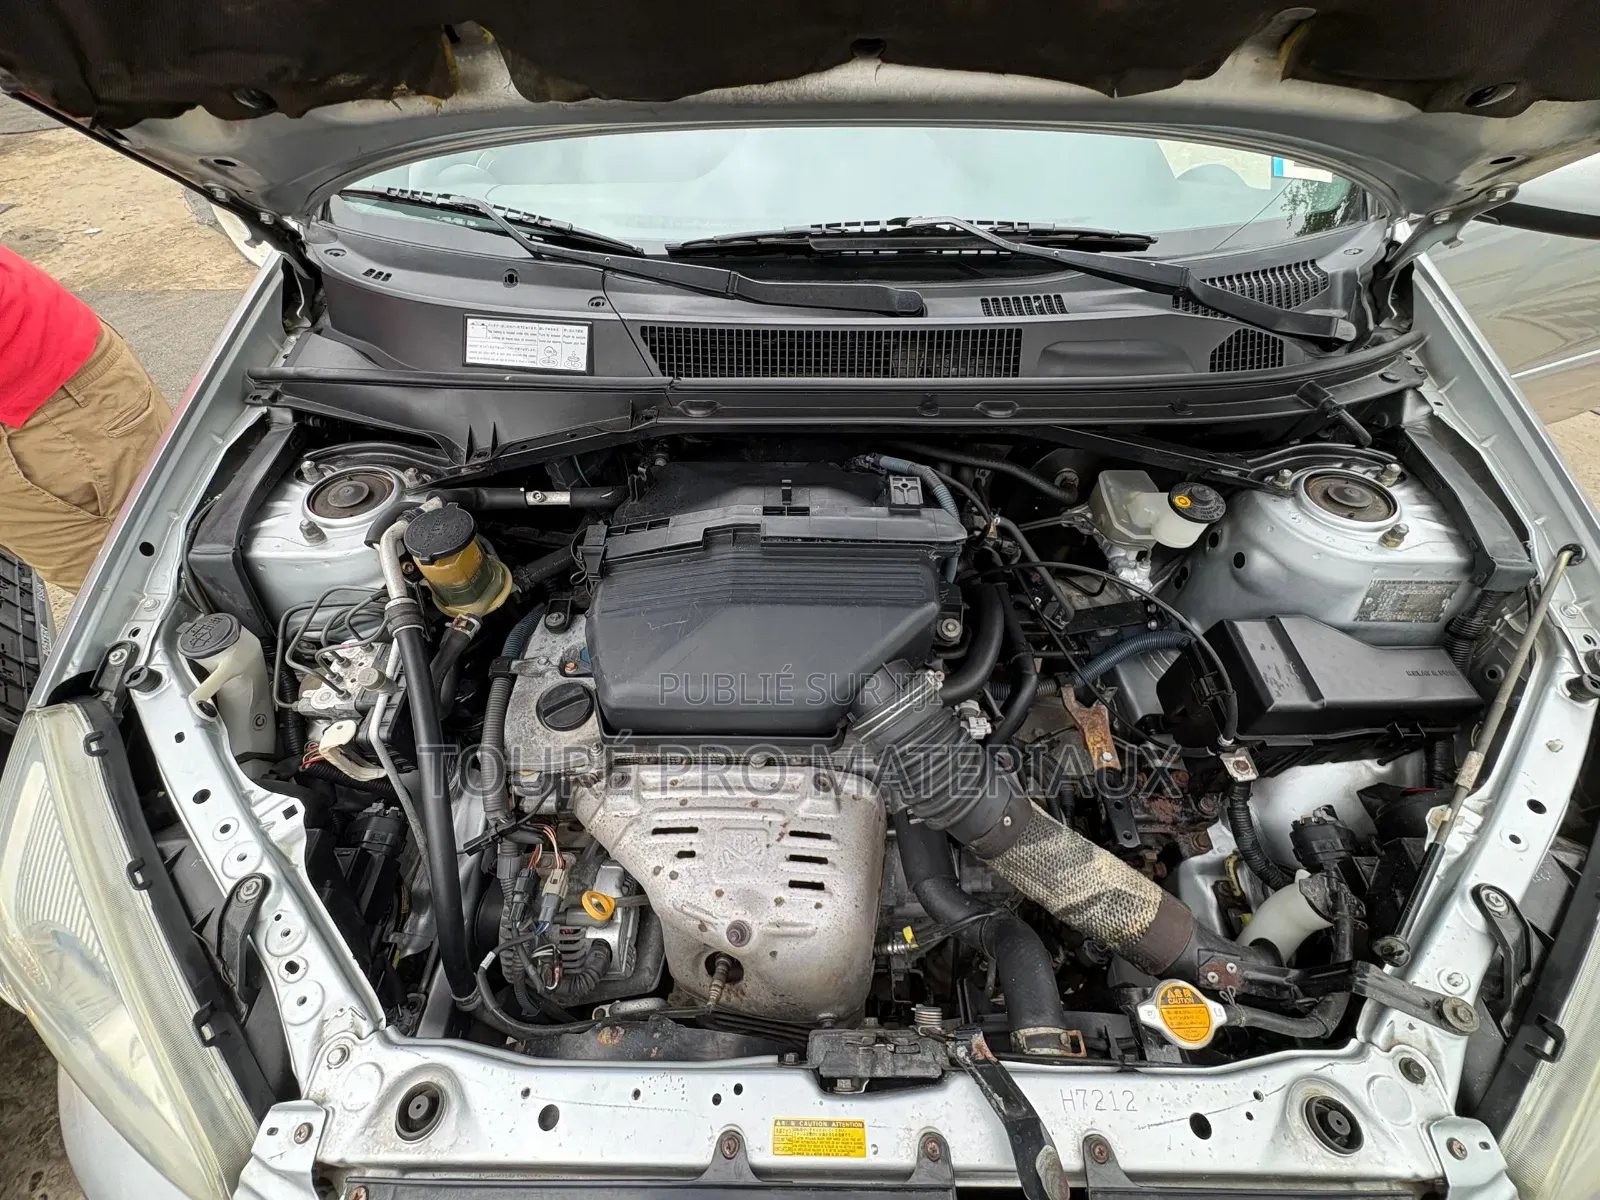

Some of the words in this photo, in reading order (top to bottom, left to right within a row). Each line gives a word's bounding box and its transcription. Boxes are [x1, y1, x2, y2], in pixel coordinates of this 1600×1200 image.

[1167, 997, 1195, 1005] CAUTION
[1059, 1088, 1138, 1112] H7212
[799, 1120, 828, 1128] CAUTION
